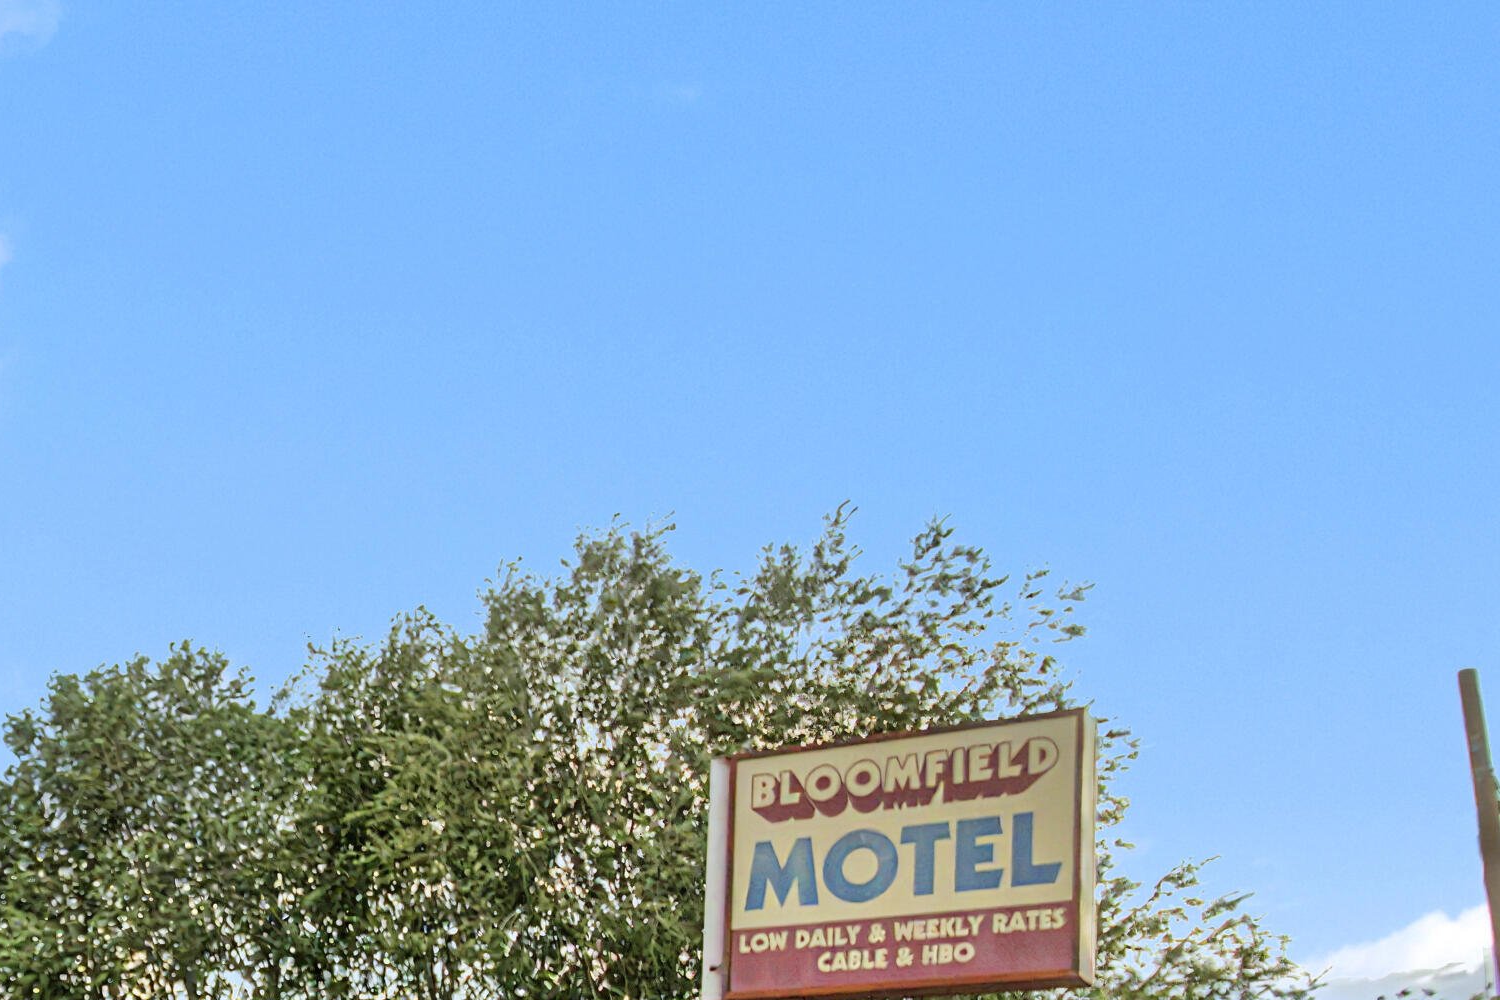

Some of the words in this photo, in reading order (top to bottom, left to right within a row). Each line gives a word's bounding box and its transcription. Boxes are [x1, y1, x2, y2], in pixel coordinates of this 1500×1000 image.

[751, 736, 1060, 823] BLOOMFIELD
[745, 811, 1063, 911] MOTEL
[739, 930, 788, 954] LOW
[795, 925, 861, 949] DAILY
[868, 923, 886, 943] &
[894, 914, 984, 941] WEEKLY
[992, 908, 1067, 934] RATES
[817, 948, 888, 972] CABLE
[896, 947, 914, 967] &
[922, 942, 975, 966] HBO
